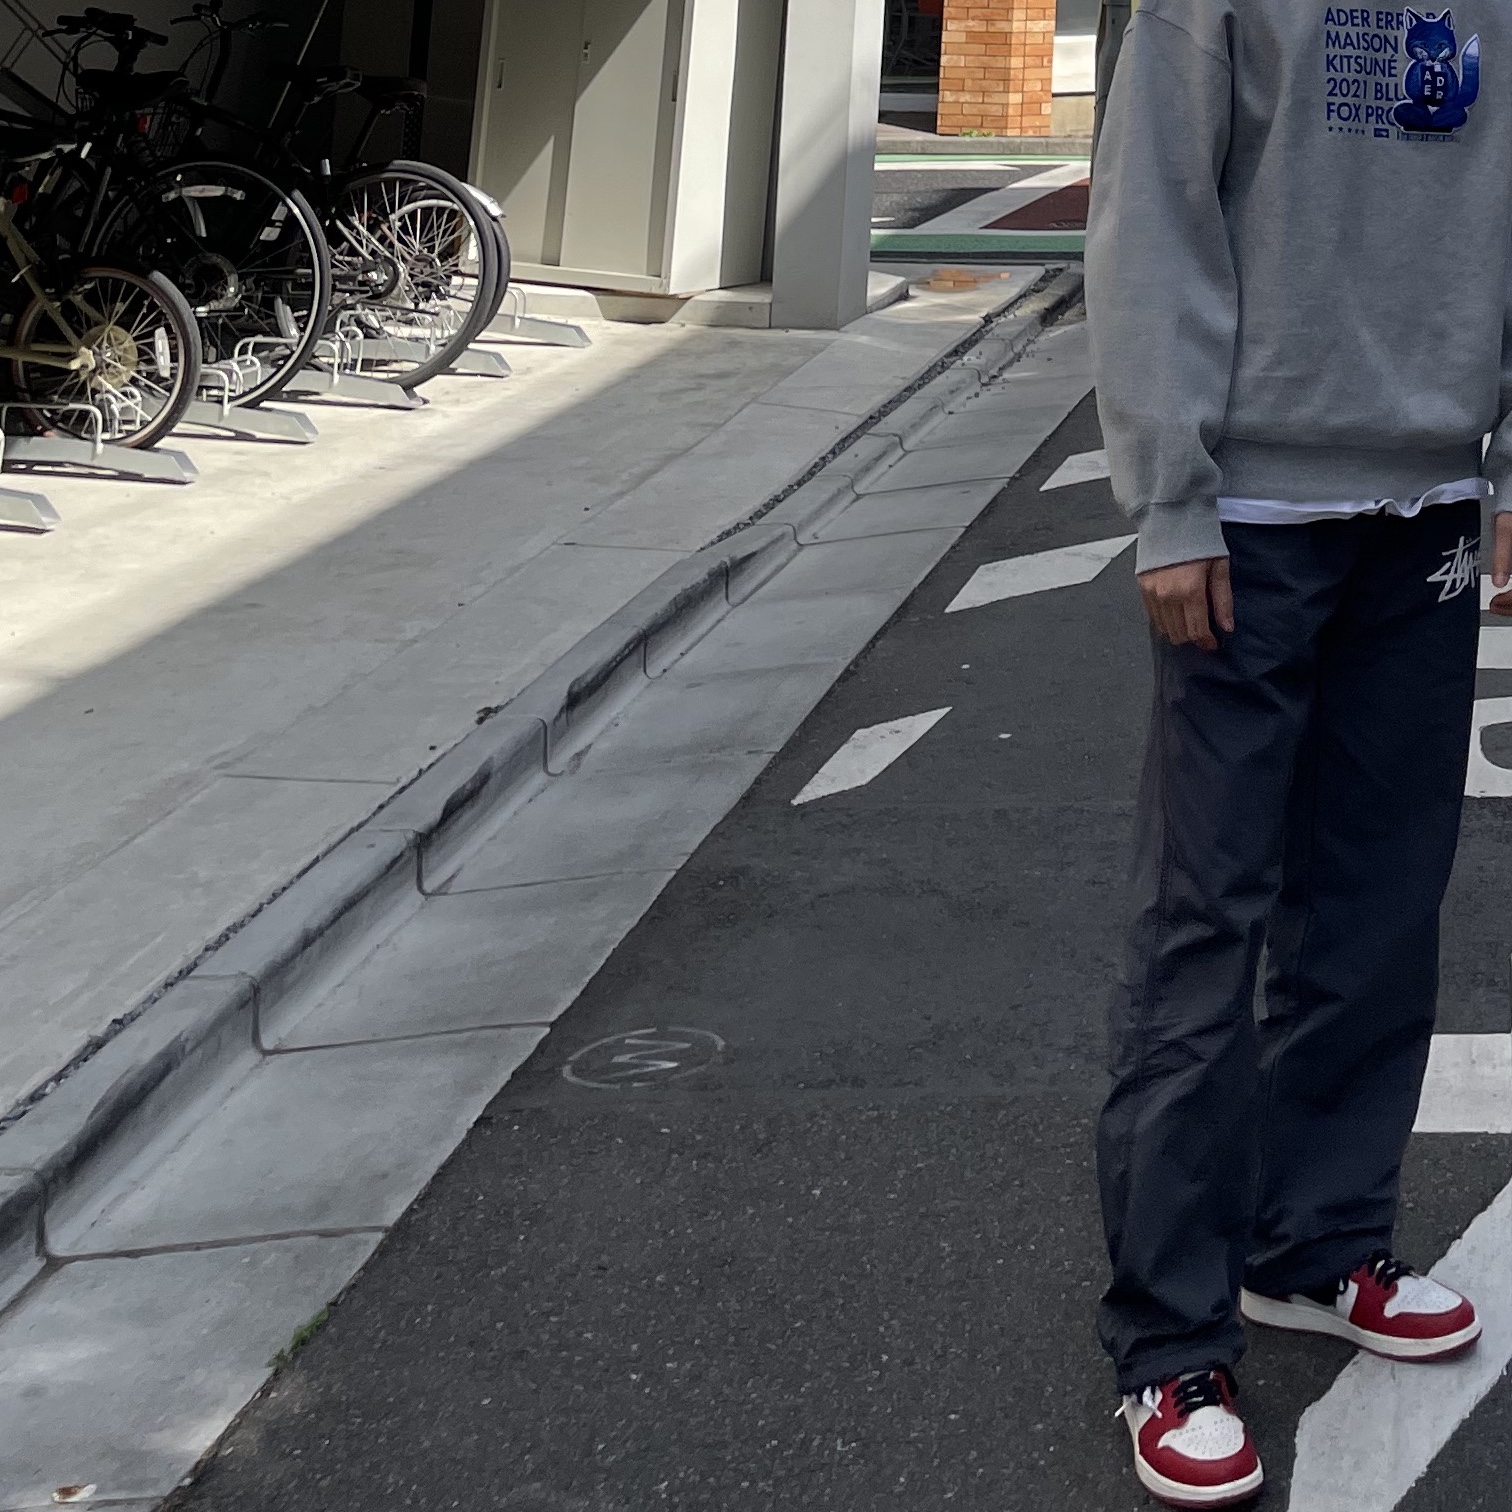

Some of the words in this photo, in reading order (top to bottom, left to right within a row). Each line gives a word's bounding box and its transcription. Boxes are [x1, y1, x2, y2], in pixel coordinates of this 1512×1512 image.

[1324, 7, 1371, 28] ADER
[1325, 30, 1398, 54] MAISON
[1326, 54, 1397, 77] KITSUNÉ
[1326, 77, 1367, 99] 2021
[1326, 102, 1361, 123] FOX
